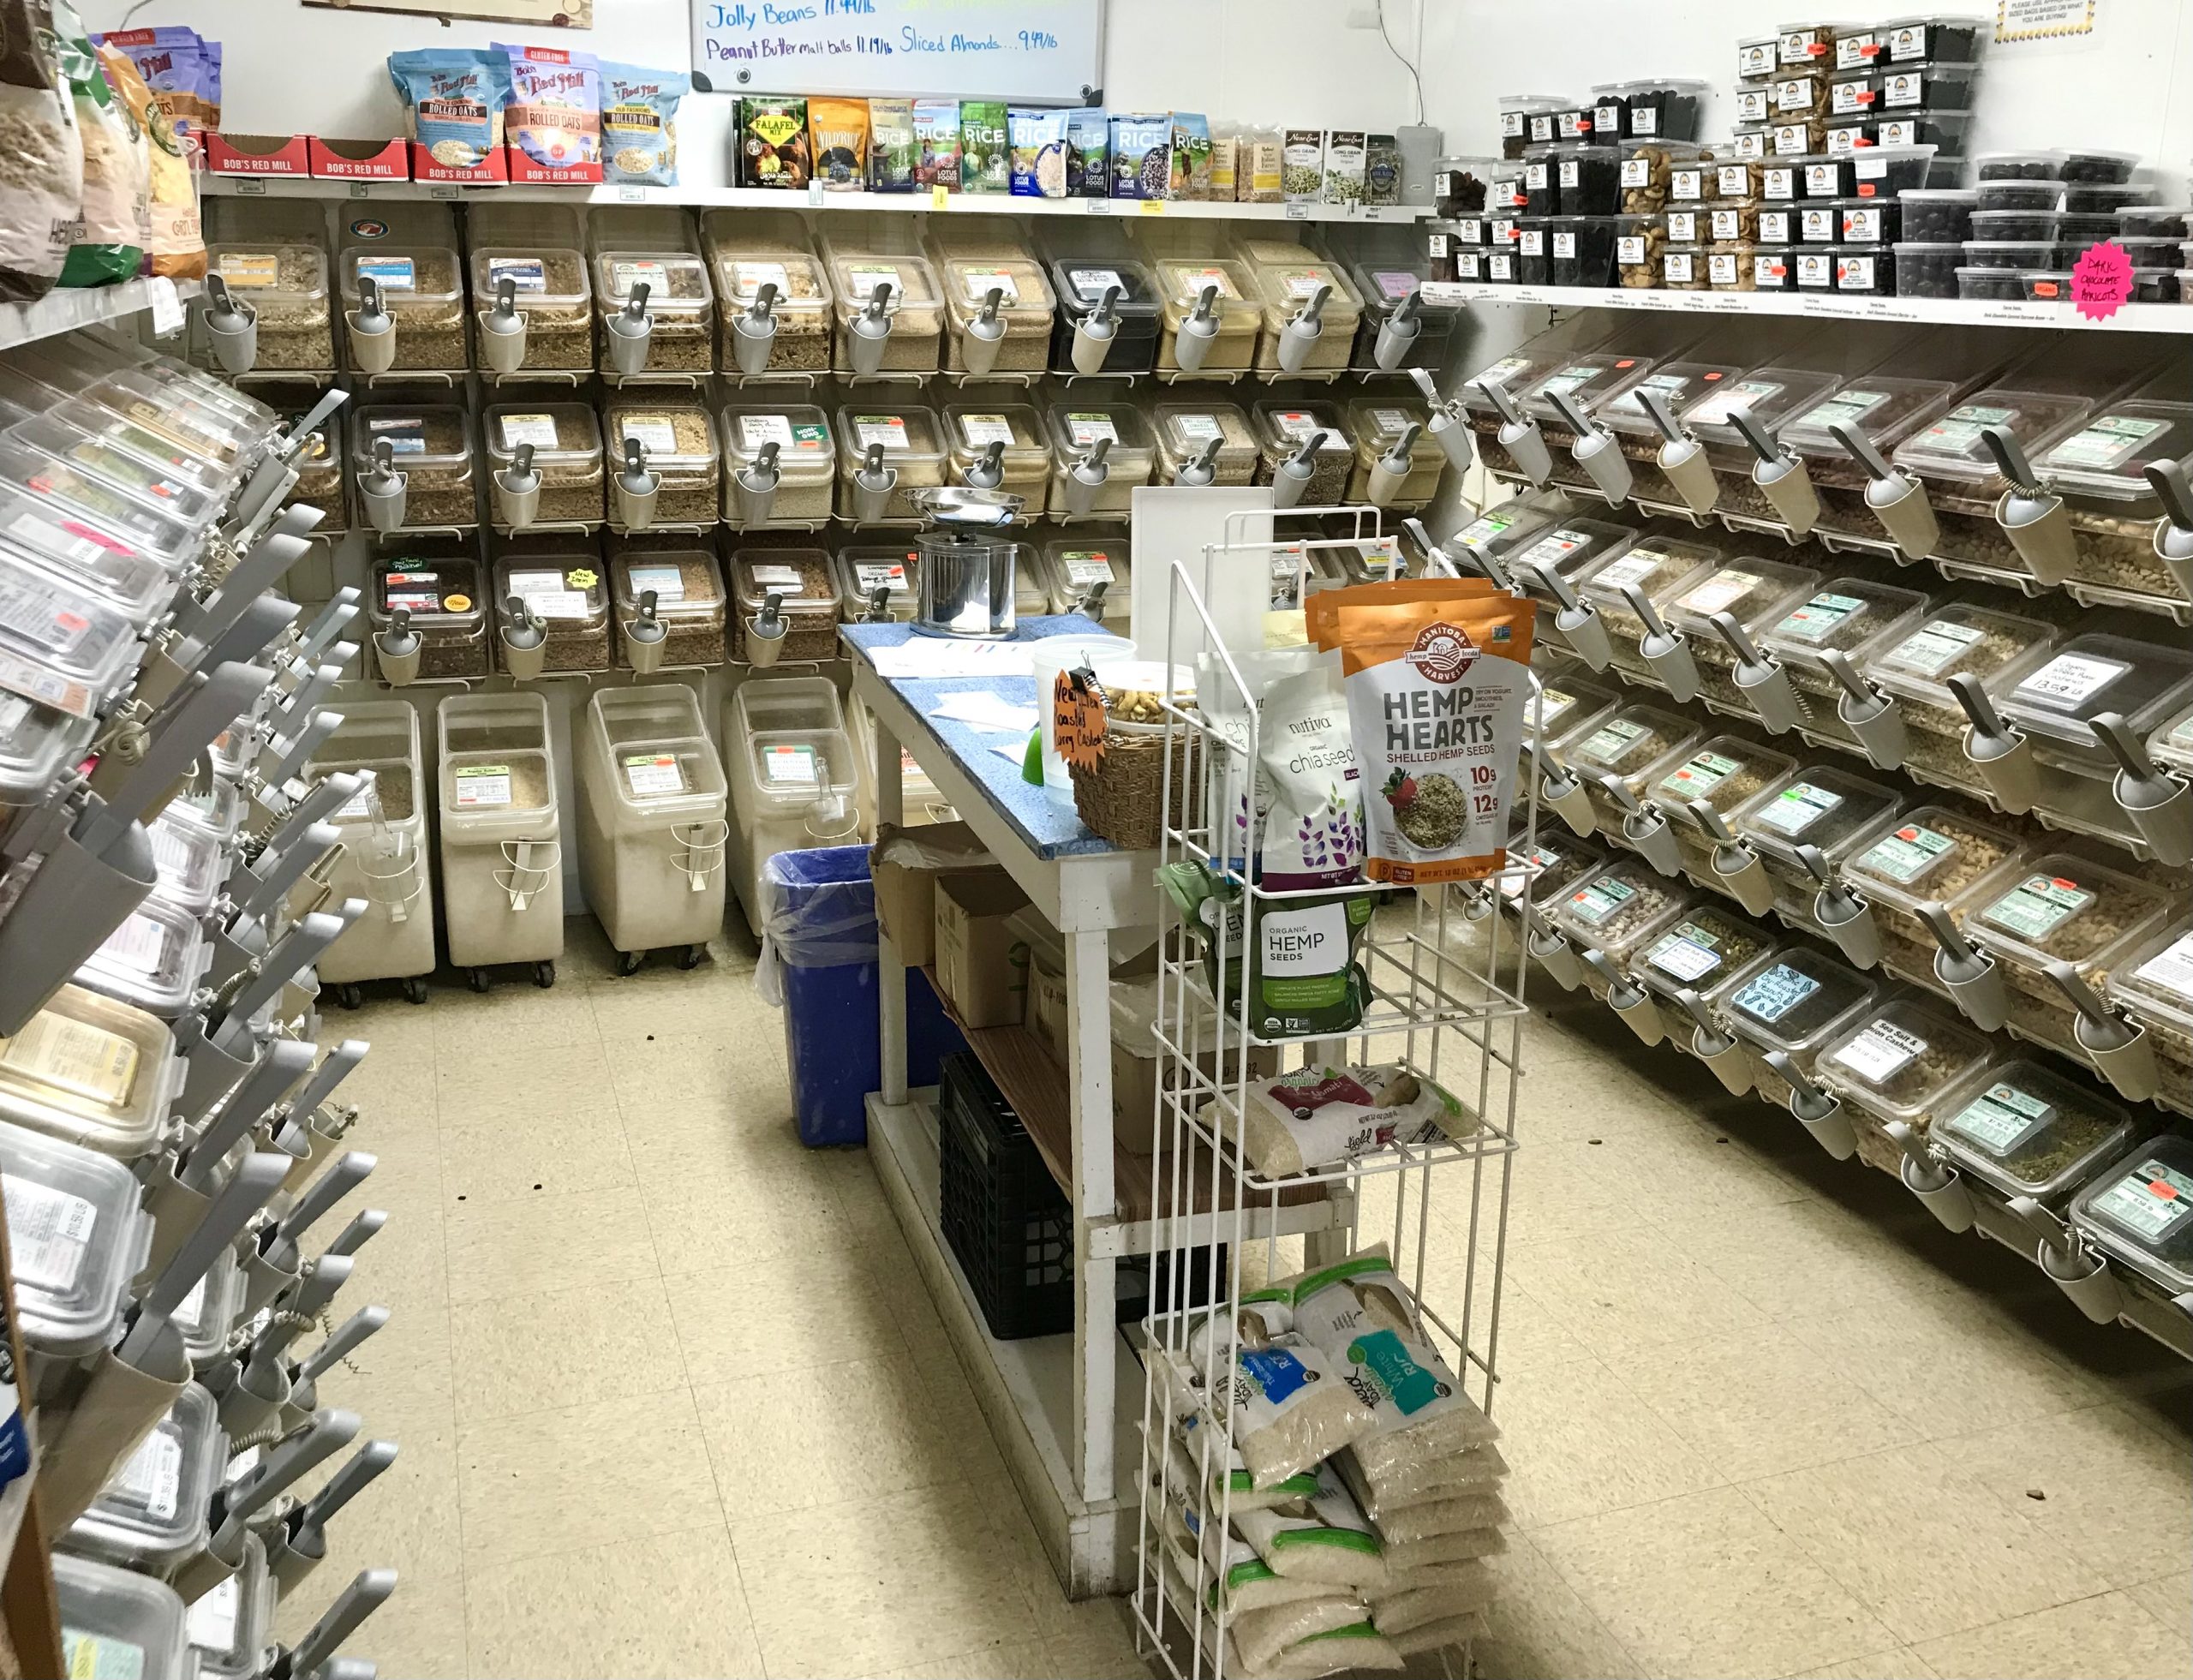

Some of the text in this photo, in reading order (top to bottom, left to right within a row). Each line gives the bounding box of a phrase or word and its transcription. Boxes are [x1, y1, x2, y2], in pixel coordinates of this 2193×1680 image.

[706, 3, 817, 31] Jolly Beans
[900, 26, 946, 52] Sliced
[706, 39, 758, 60] Peanut
[762, 38, 796, 58] Butter
[828, 39, 852, 55] balls
[529, 71, 585, 96] Red Mill
[429, 104, 478, 117] ROLLED OATS
[529, 113, 581, 130] ROLLED OATS
[612, 113, 654, 126] ROLLED OATS
[756, 120, 796, 130] FALAFEL
[876, 132, 910, 145] RICE
[917, 127, 956, 140] RICE
[965, 129, 1006, 143] RICE
[1014, 128, 1059, 144] RICE
[1119, 132, 1164, 147] RICE
[1176, 135, 1209, 150] RICE
[224, 159, 292, 171] BOB'S RED MILL
[326, 163, 393, 176] BOB'S RED MILL
[429, 169, 493, 179] BOB'S RED MILL
[527, 170, 589, 180] BOB'S RED MILL
[2088, 258, 2118, 272] DARK
[2081, 275, 2120, 287] CHOCOLATE
[2081, 289, 2118, 302] APRICOTS
[797, 427, 817, 435] NON-
[1419, 626, 1467, 646] MANITOBA
[1424, 664, 1464, 680] HARVEST
[1384, 686, 1473, 720] HEMP
[1289, 716, 1332, 735] nutiva
[1386, 714, 1494, 751] HEARTS
[1290, 744, 1355, 774] chia seed
[1387, 744, 1495, 763] SHELLED HEMP SEEDS
[1471, 766, 1497, 784] 10g
[1473, 794, 1498, 813] 12g
[1270, 932, 1324, 951] HEMP
[1270, 953, 1303, 961] SEEDS
[1879, 1022, 1893, 1033] Sea
[1894, 1031, 1910, 1042] Salt
[1868, 1027, 1919, 1058] nion Cashews
